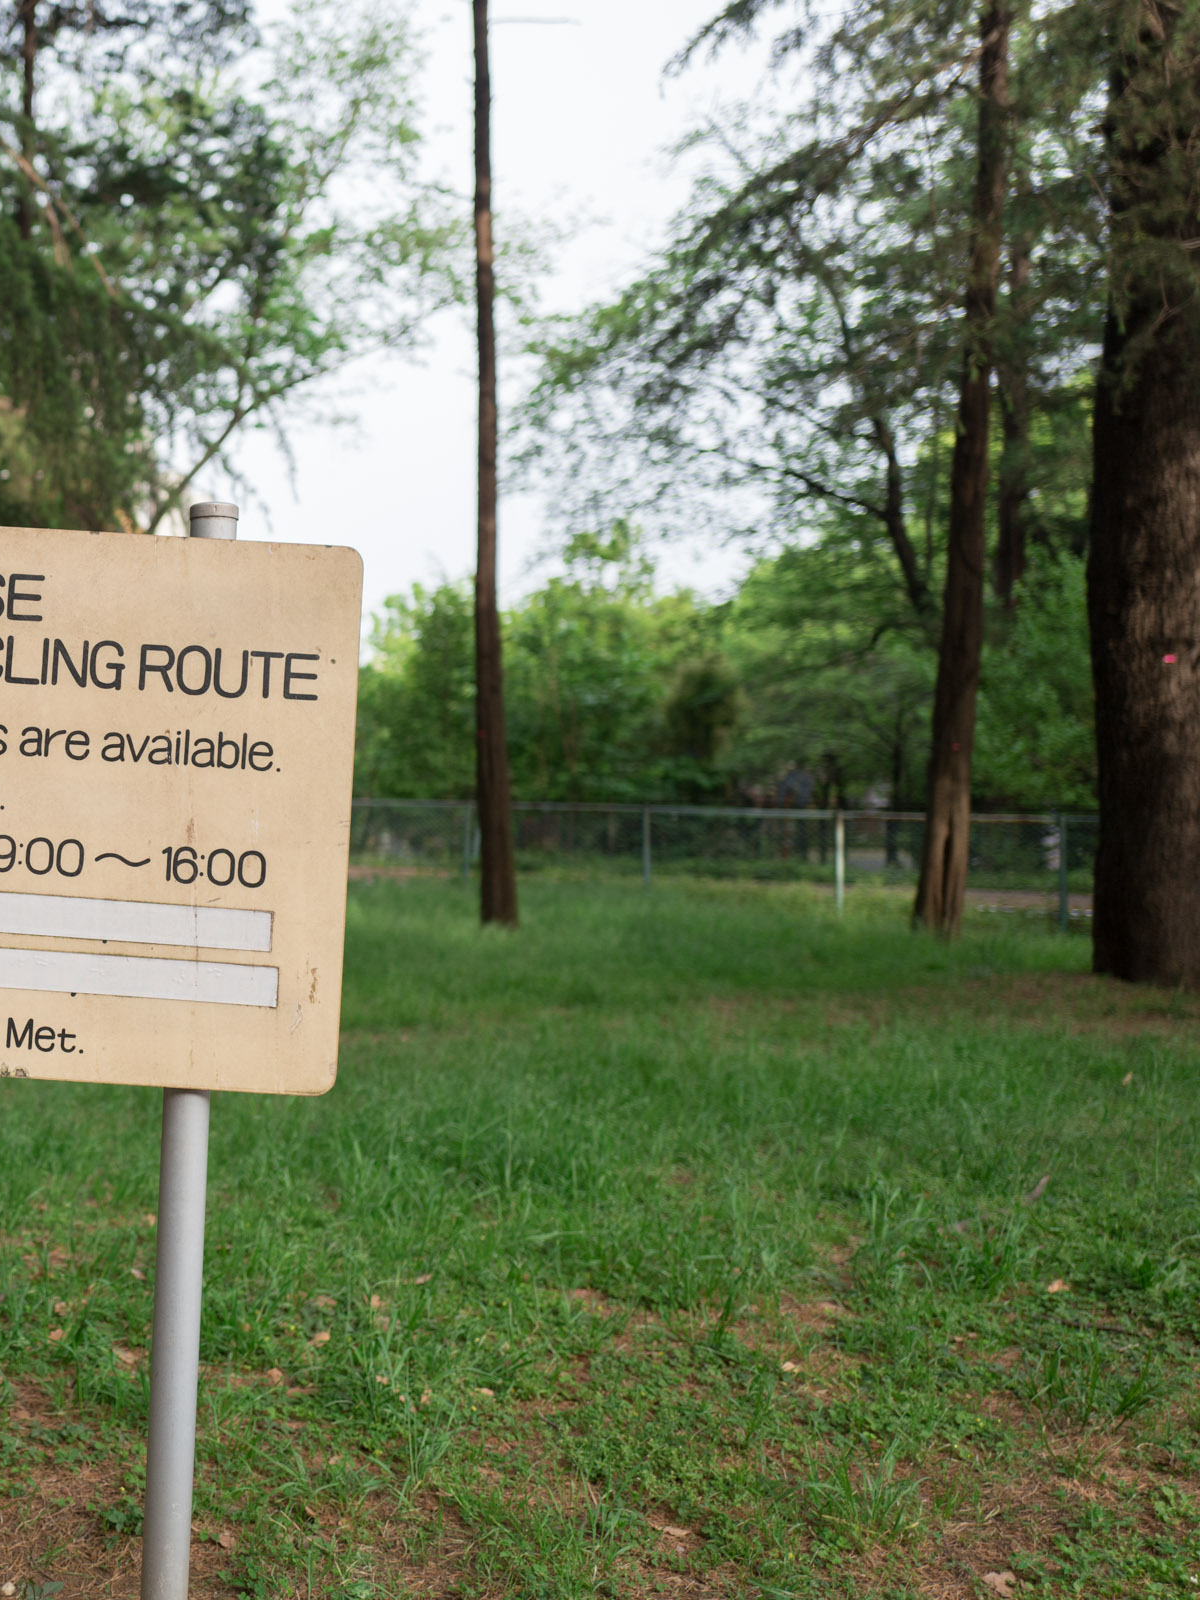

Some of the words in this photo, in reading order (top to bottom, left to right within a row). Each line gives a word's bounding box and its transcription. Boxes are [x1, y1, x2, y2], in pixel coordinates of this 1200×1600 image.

[139, 644, 319, 701] ROUTE
[20, 727, 89, 761] are
[102, 730, 282, 773] available.
[162, 847, 266, 889] 16:00
[6, 1018, 84, 1054] Met.
